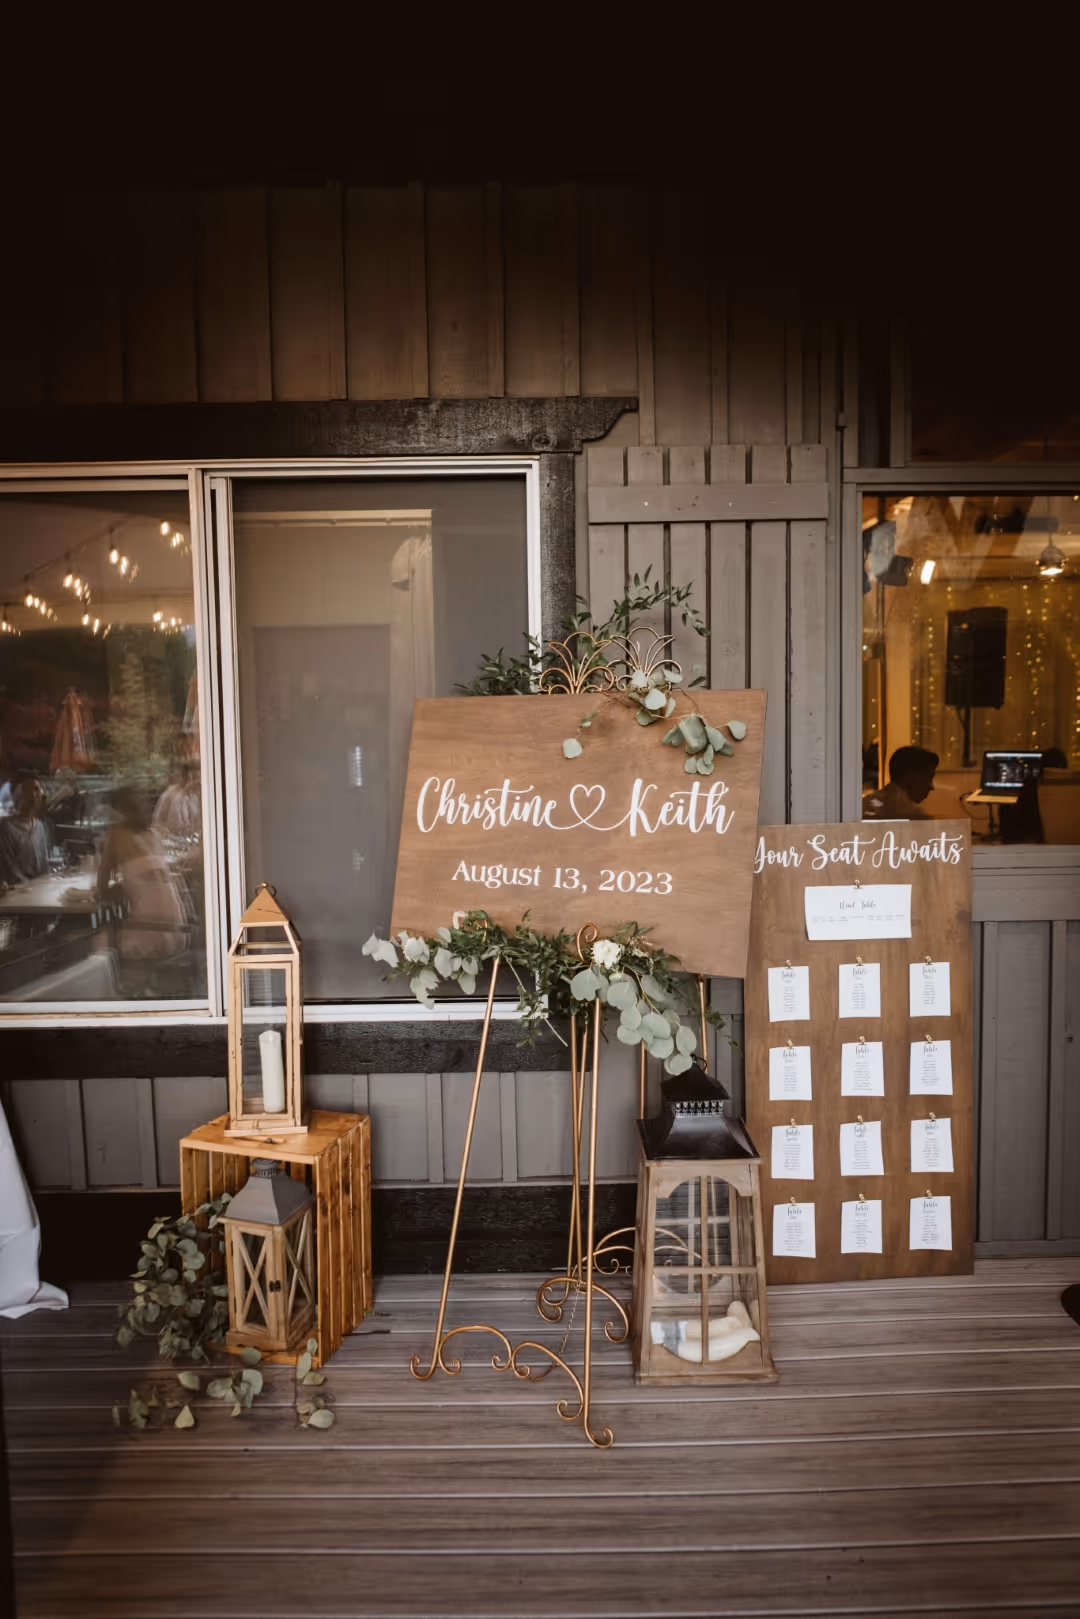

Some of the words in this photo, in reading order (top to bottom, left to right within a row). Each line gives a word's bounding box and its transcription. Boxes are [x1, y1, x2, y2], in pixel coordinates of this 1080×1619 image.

[416, 776, 558, 832] Christine
[628, 778, 735, 837] Keith
[753, 836, 804, 873] Your
[807, 834, 876, 871] Seat
[872, 831, 964, 869] Awaits
[451, 860, 541, 889] August
[552, 867, 587, 894] 13,
[598, 869, 673, 895] 2023
